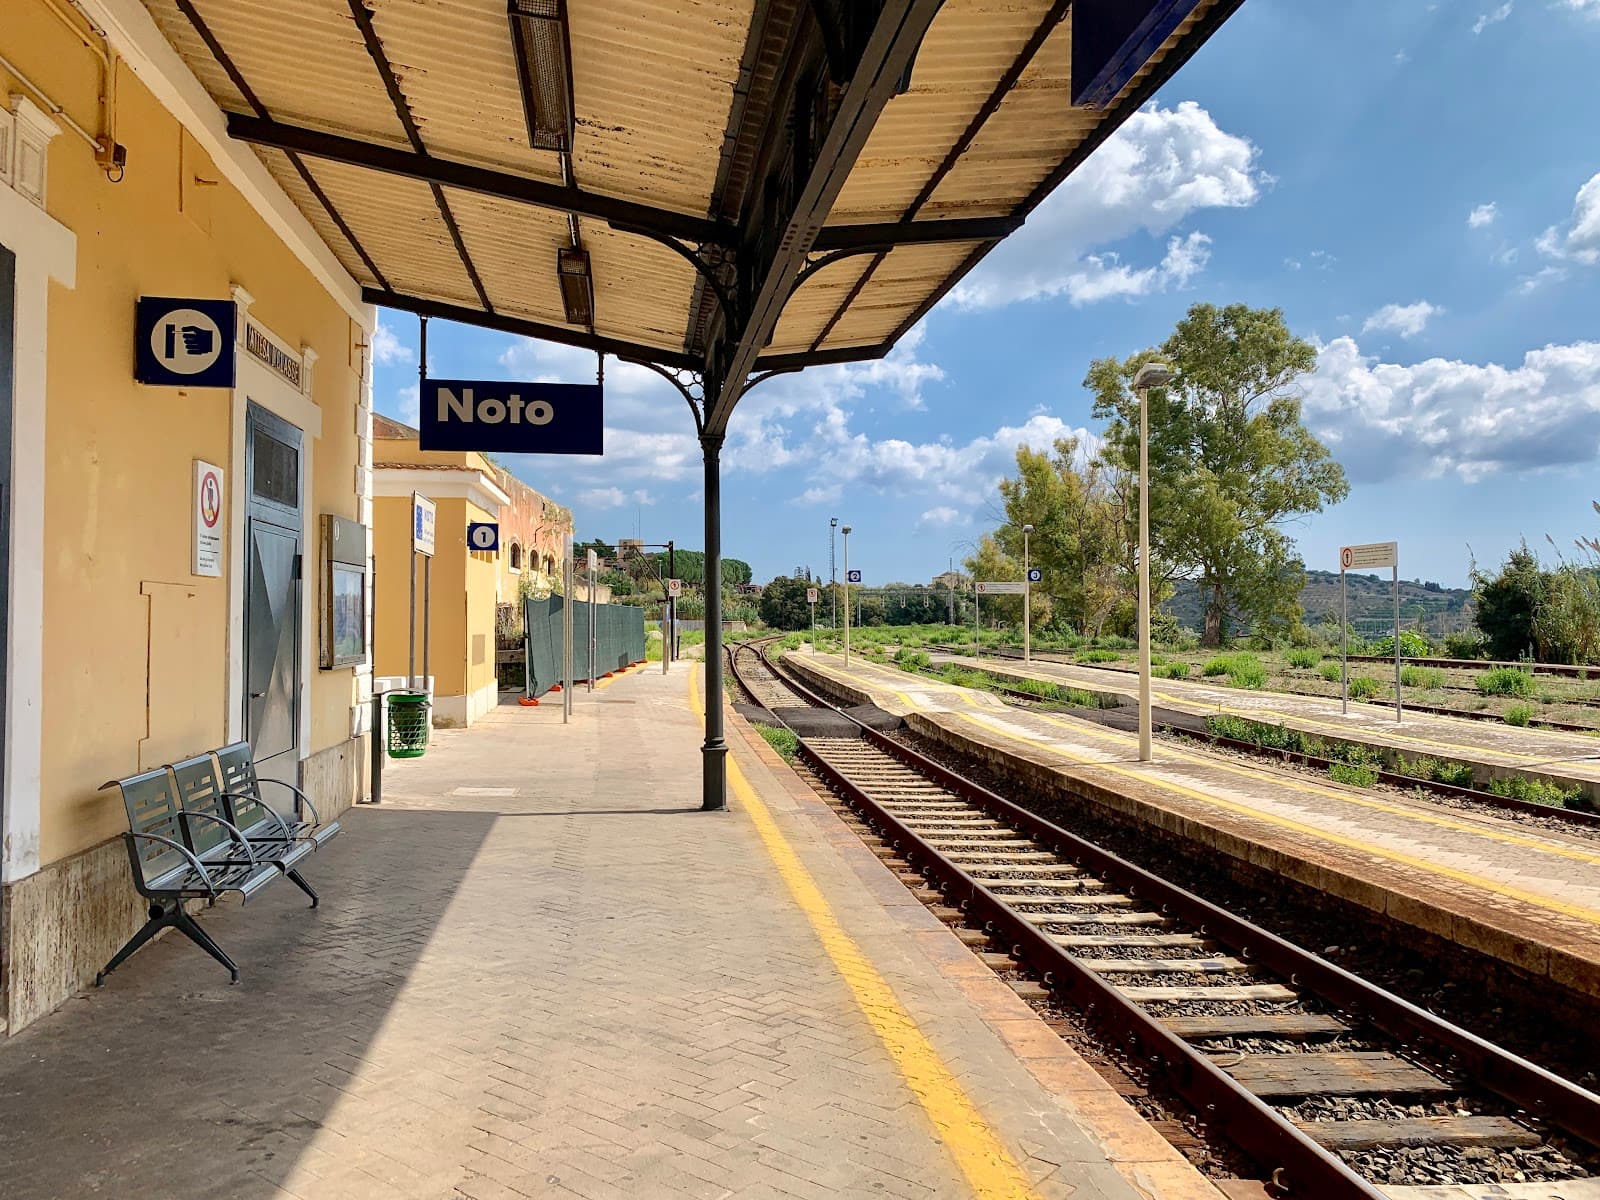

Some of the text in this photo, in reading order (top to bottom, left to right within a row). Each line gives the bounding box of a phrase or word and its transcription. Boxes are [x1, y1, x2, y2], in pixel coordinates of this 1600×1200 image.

[249, 326, 270, 363] ATTESA
[437, 387, 554, 426] Noto
[480, 531, 487, 543] 1
